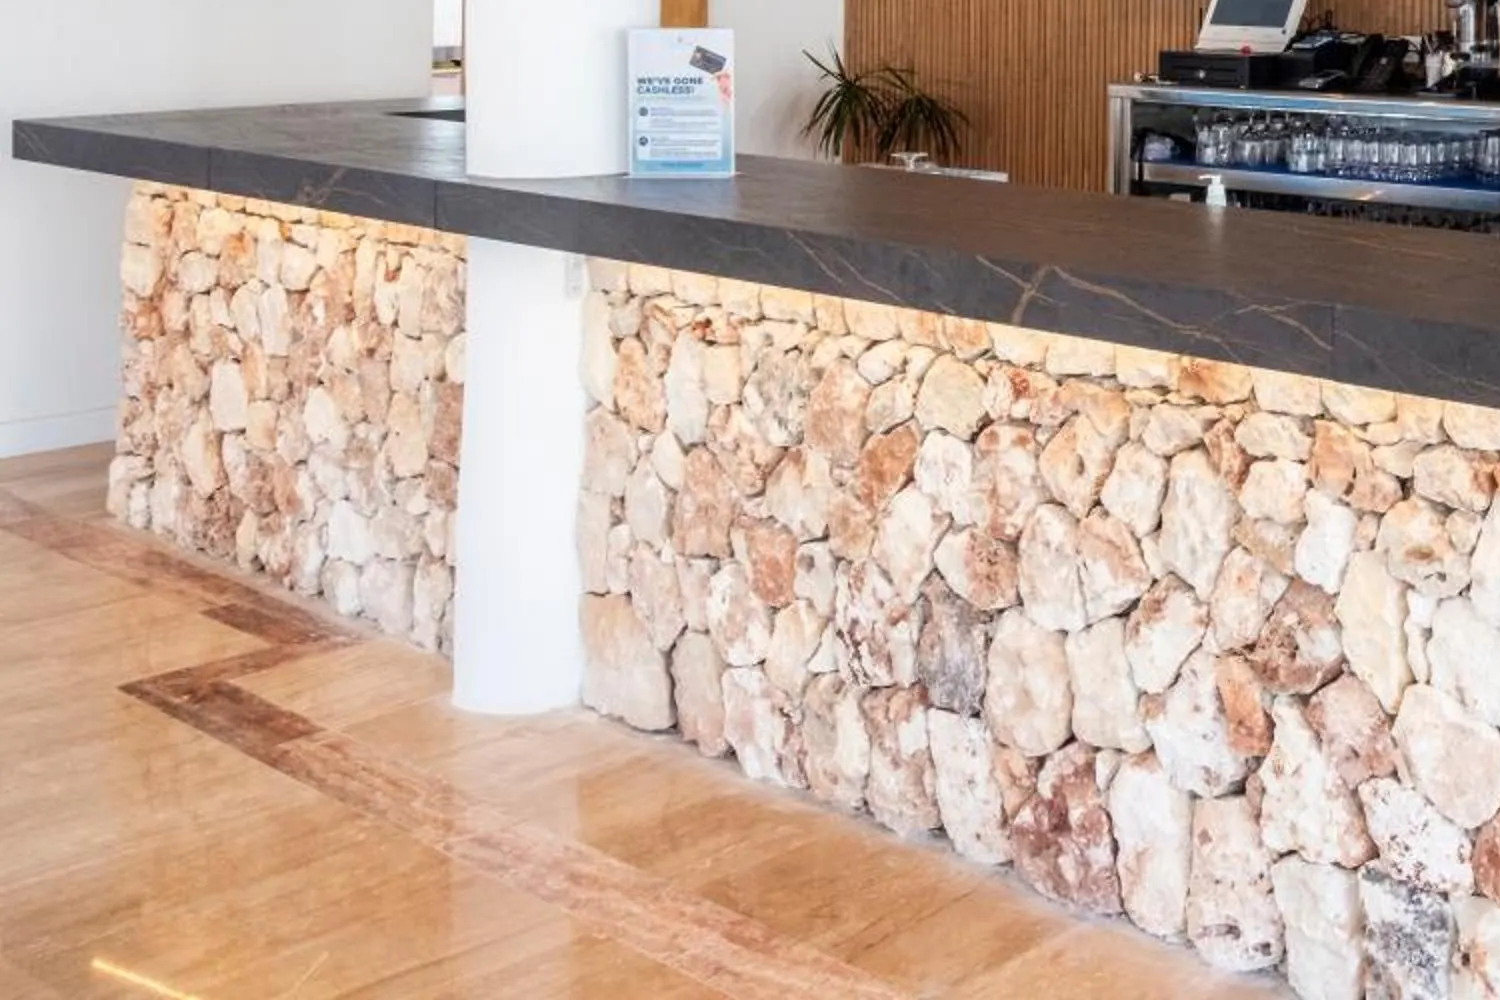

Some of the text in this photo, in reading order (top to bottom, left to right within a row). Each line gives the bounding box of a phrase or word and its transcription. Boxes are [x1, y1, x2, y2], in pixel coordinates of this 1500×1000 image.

[637, 77, 703, 85] WE'VE GONE
[637, 85, 694, 95] CASHLESS!
